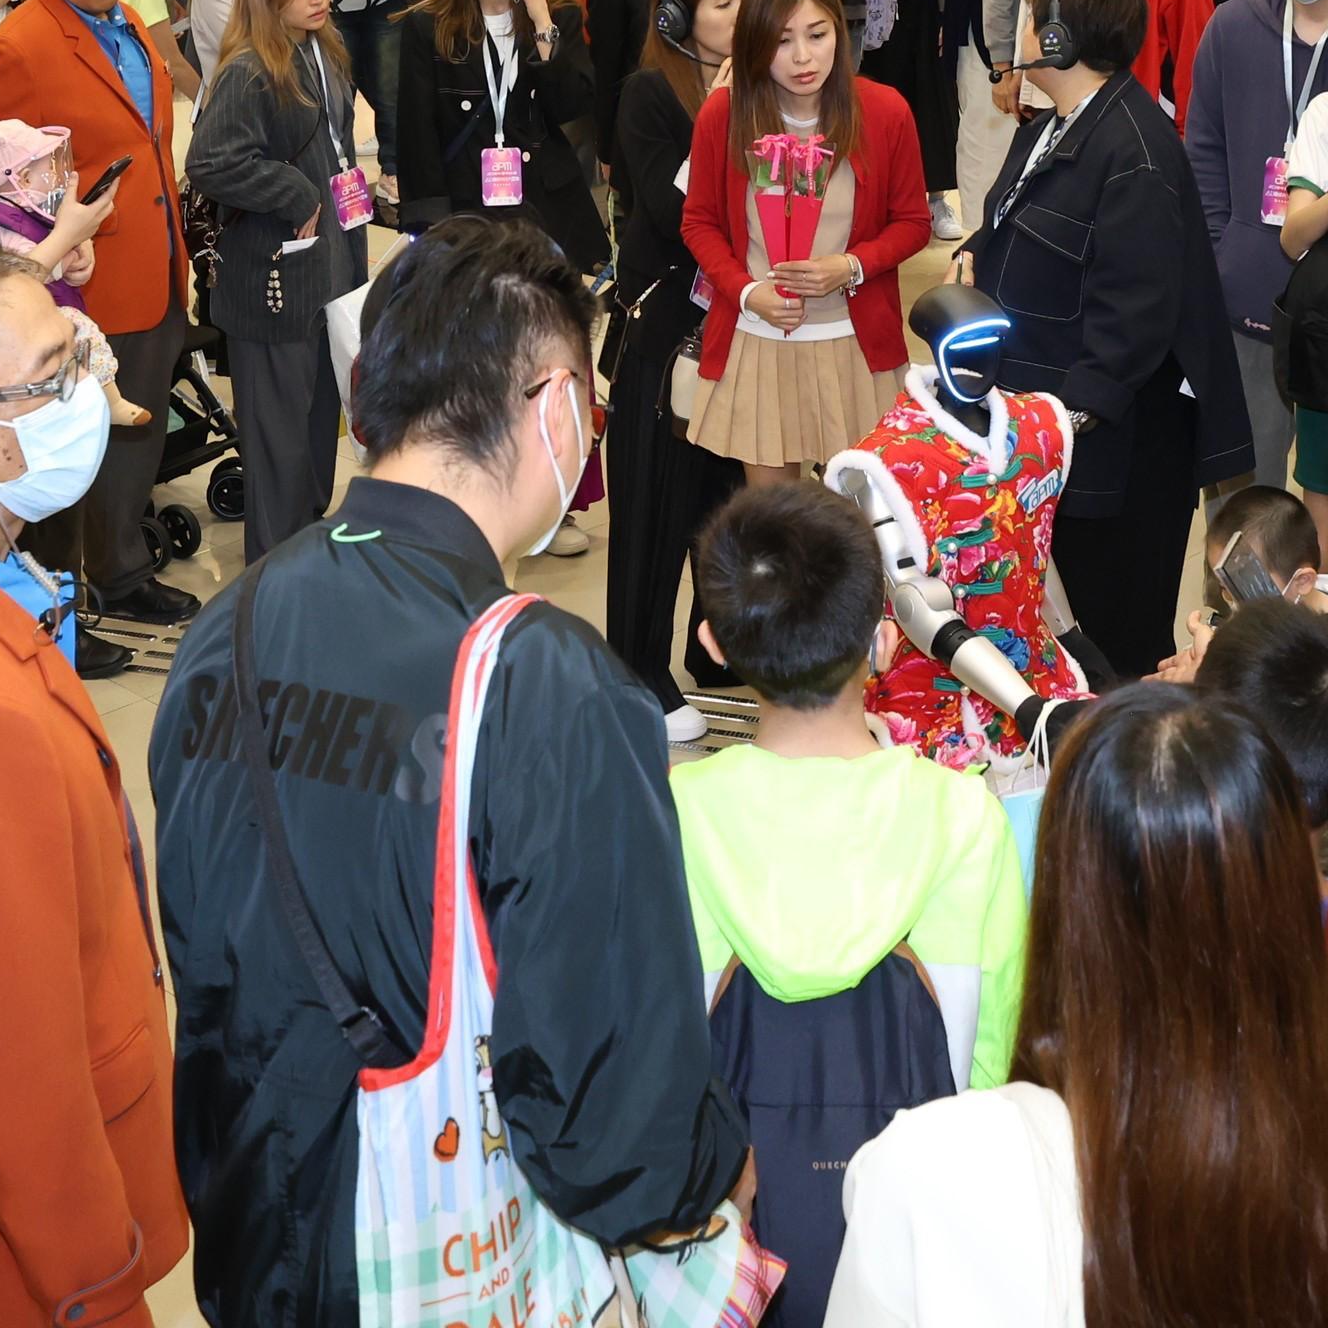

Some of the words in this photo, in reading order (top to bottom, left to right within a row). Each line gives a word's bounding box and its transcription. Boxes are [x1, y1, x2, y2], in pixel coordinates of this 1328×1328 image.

[812, 1160, 847, 1171] QUECH
[442, 1196, 521, 1278] CHIP
[478, 1267, 510, 1302] AND
